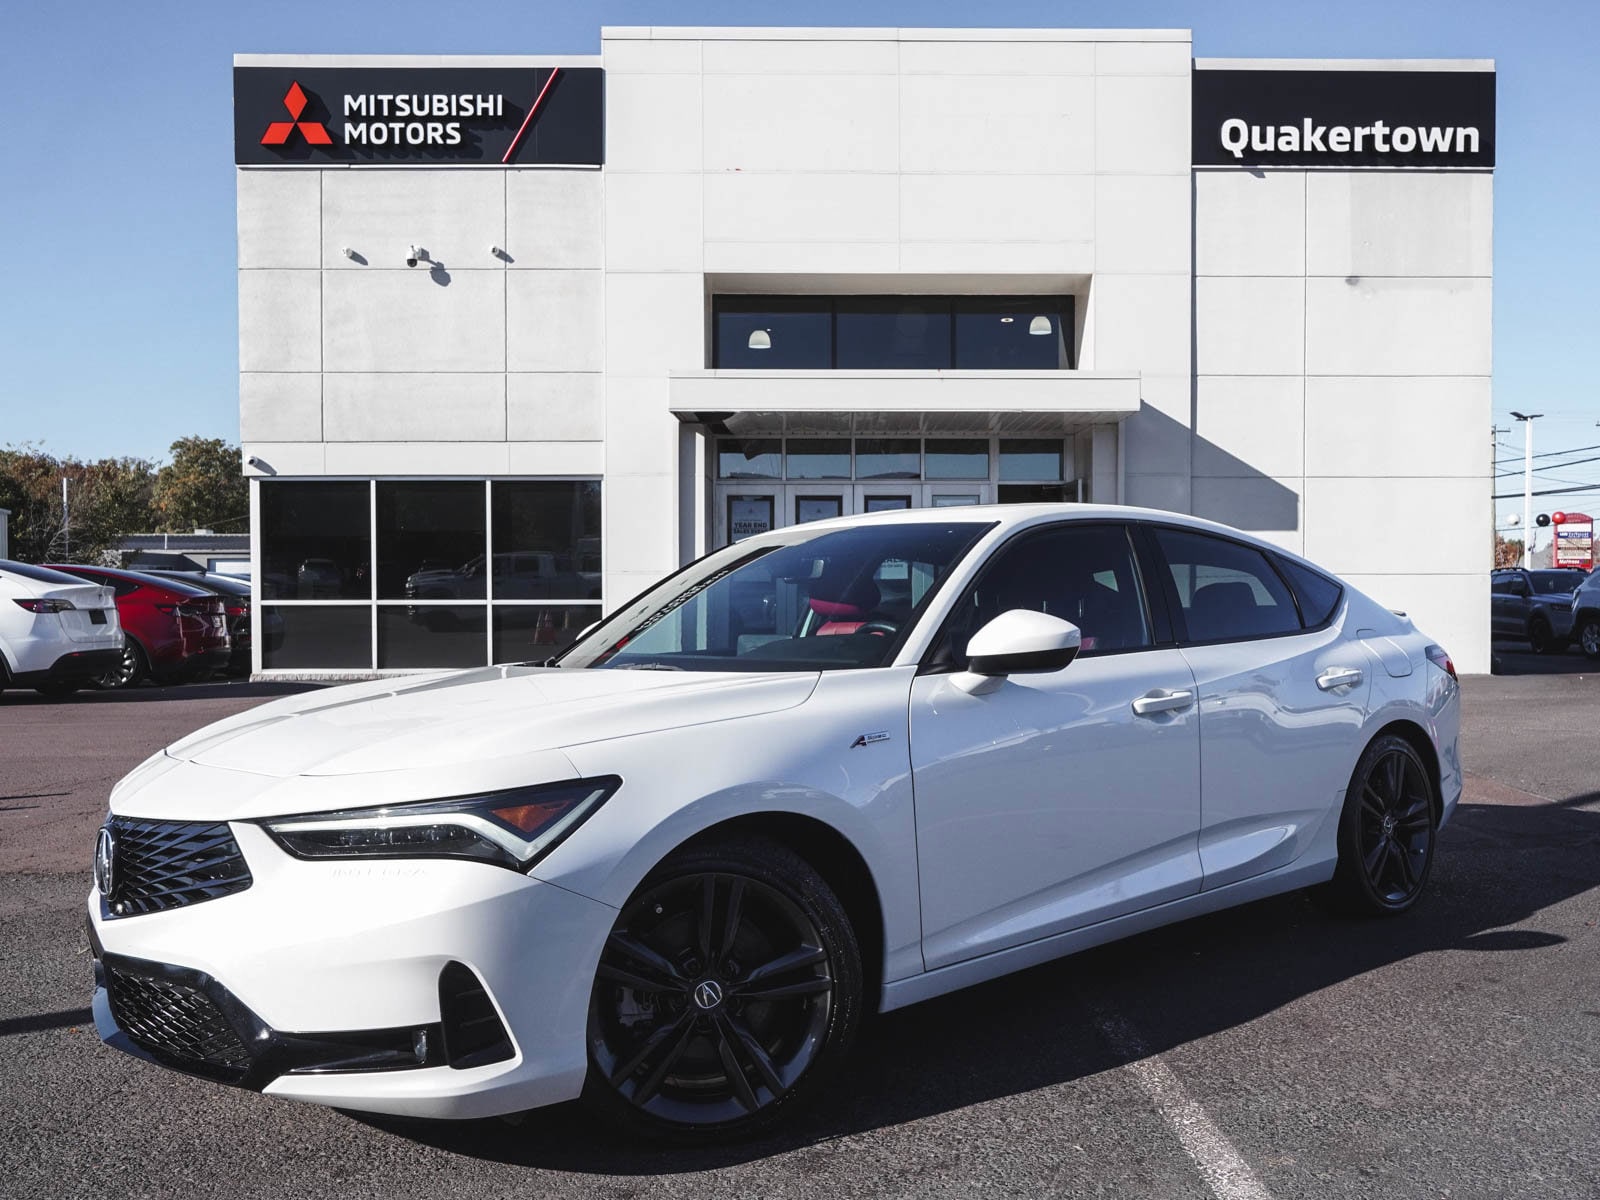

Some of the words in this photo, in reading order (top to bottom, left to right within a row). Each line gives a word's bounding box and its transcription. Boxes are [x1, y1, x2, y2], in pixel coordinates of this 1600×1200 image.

[343, 94, 503, 117] MITSUBISHI
[344, 122, 461, 145] MOTORS
[1220, 117, 1480, 158] Quakertown
